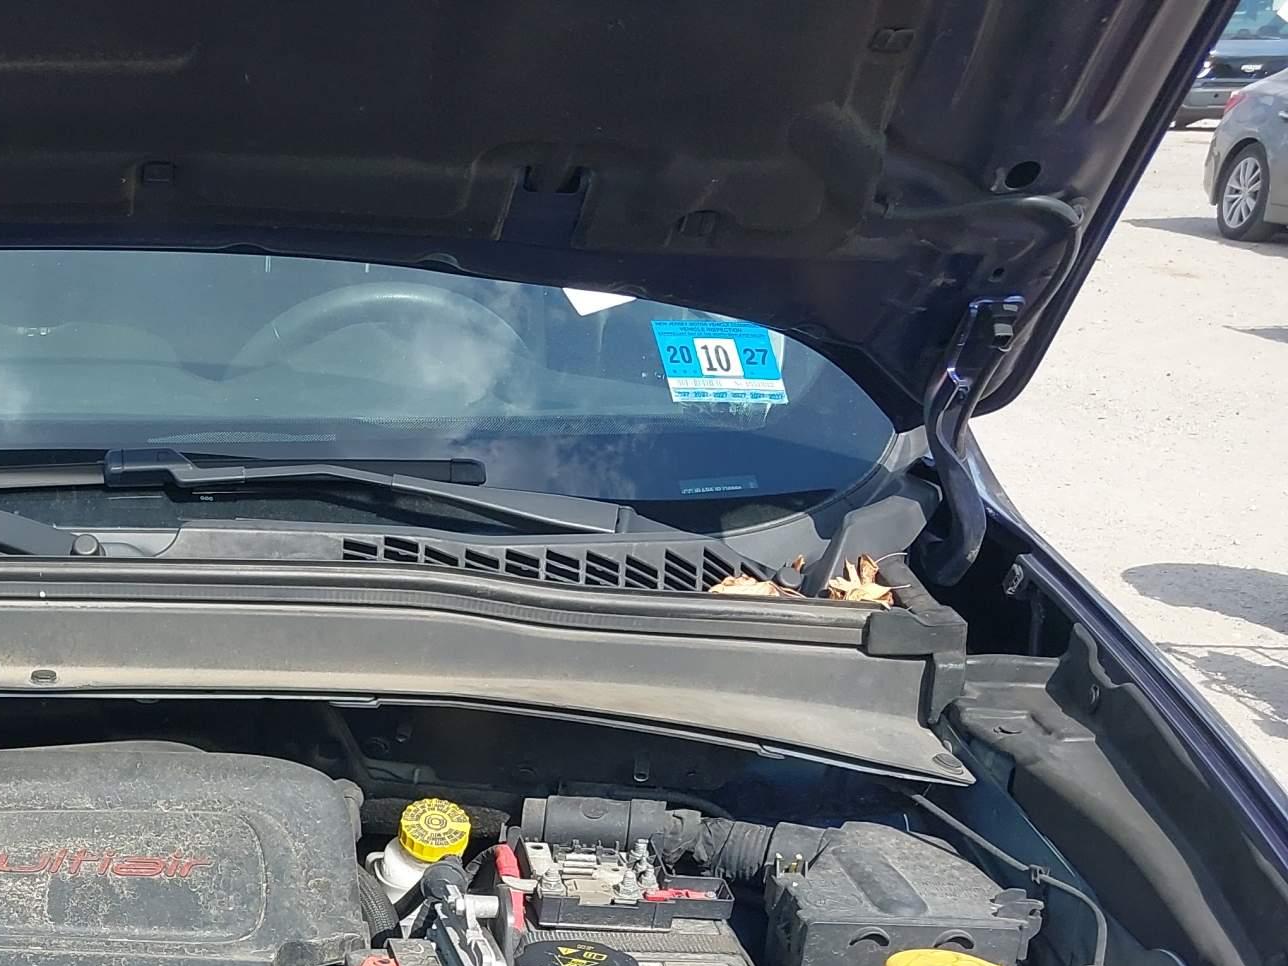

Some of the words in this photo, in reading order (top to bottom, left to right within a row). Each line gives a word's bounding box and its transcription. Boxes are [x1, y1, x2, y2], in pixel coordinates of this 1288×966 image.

[666, 345, 692, 364] 20
[700, 344, 731, 372] 10
[743, 348, 768, 366] 27
